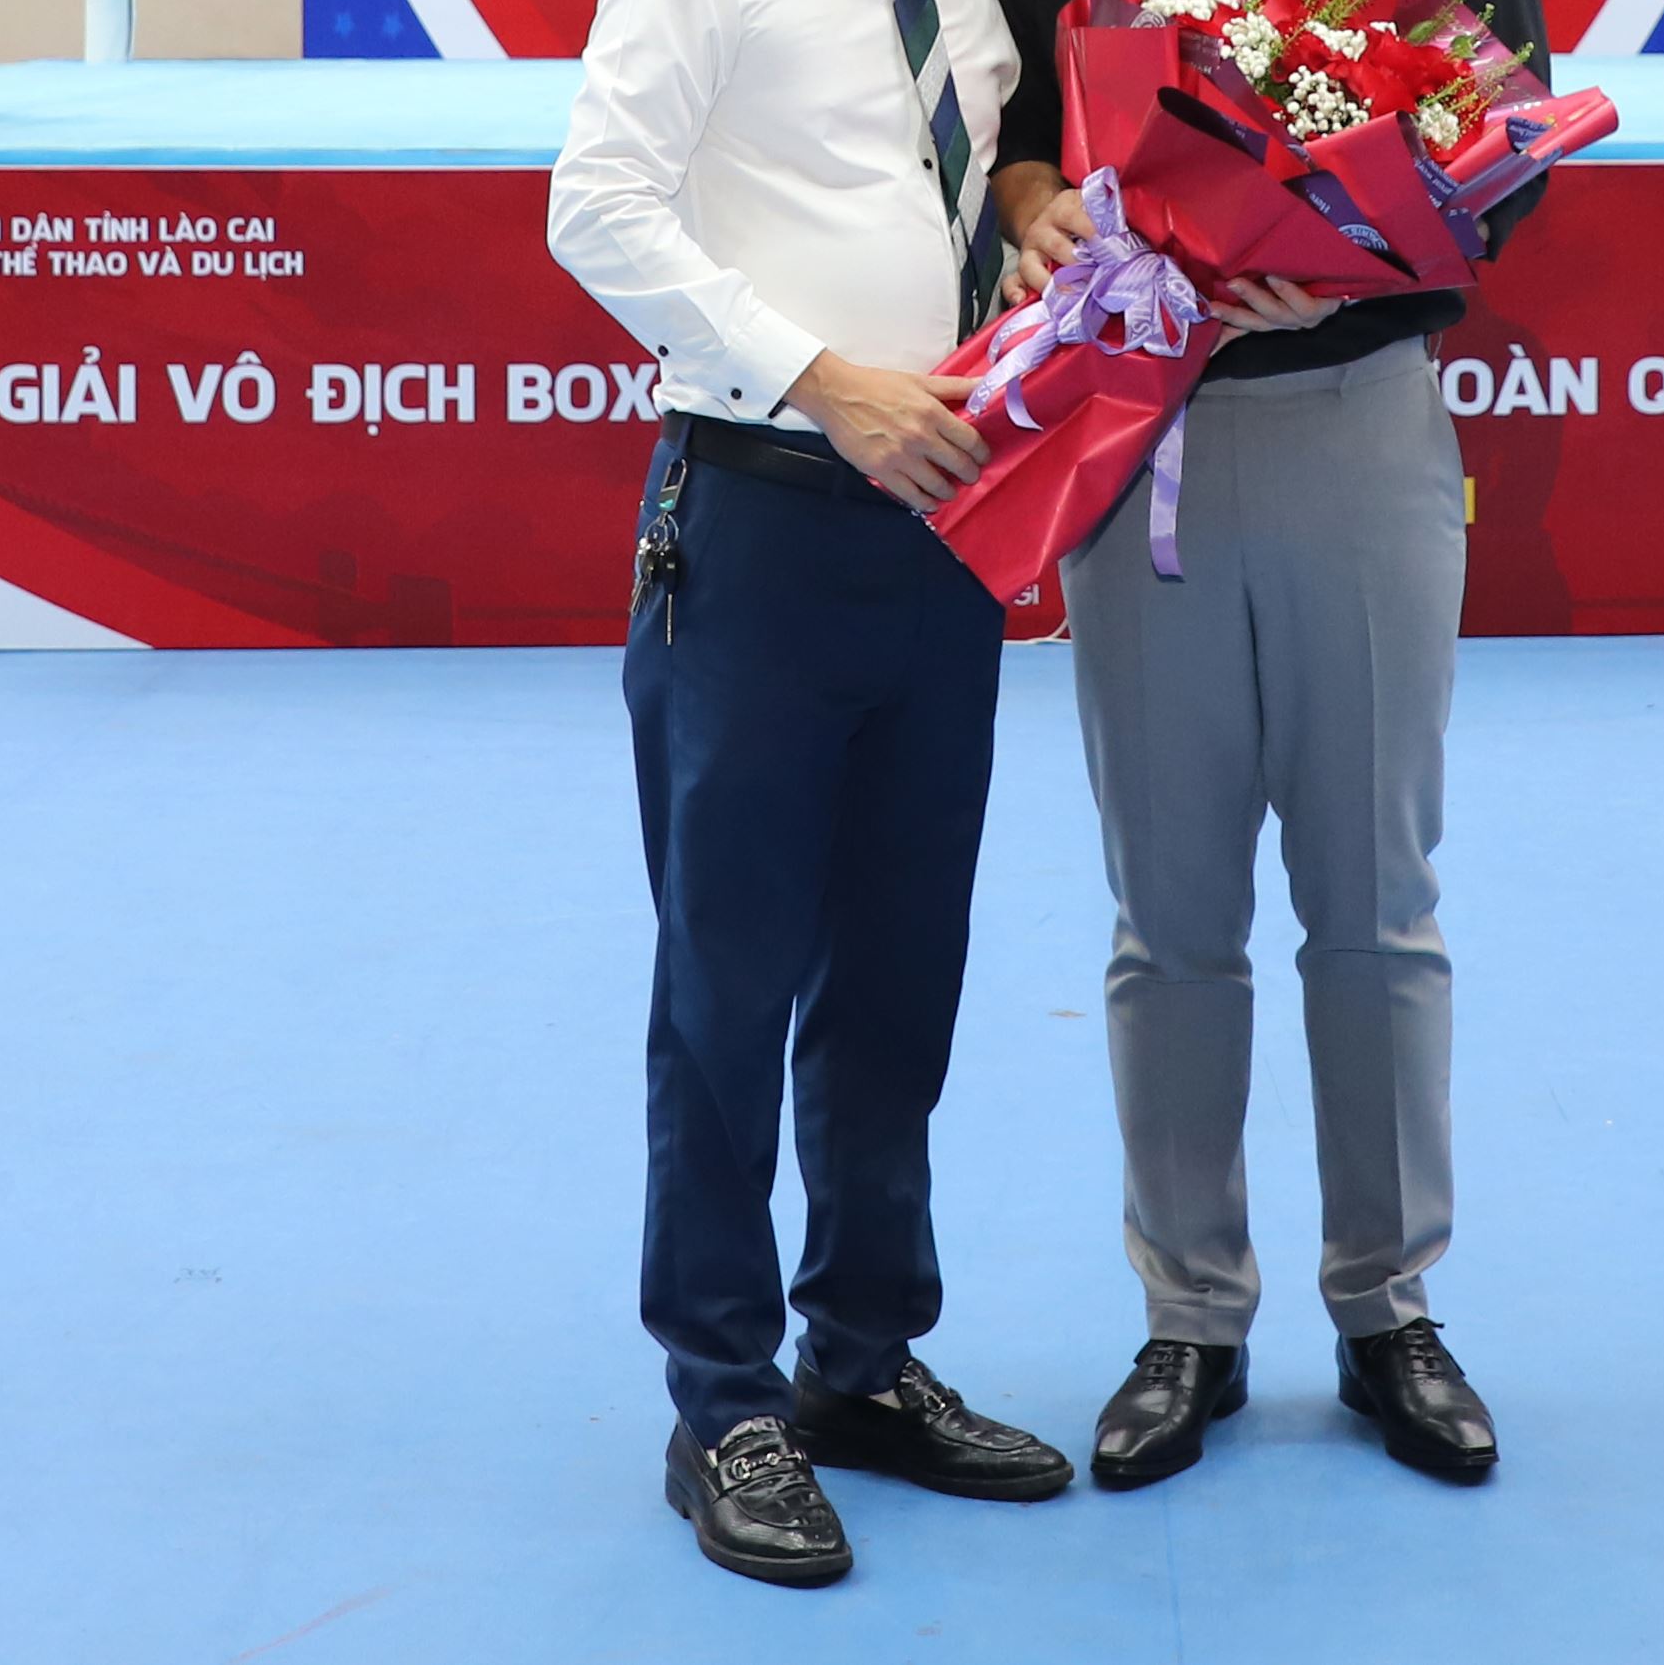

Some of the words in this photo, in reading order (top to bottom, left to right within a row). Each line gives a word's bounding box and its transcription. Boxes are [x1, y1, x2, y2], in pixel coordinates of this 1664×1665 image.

[12, 213, 73, 241] DÂN
[85, 211, 149, 241] TỈNH
[159, 213, 216, 241] LÀO
[228, 217, 274, 241] CAI
[49, 251, 127, 275] THAO
[138, 246, 182, 275] VÀ
[192, 251, 234, 275] DU
[244, 251, 304, 280] LỊCH
[167, 350, 276, 423] VÔ
[306, 363, 475, 435] ĐỊCH
[506, 363, 659, 423] BOX
[1435, 343, 1598, 416] OÀN
